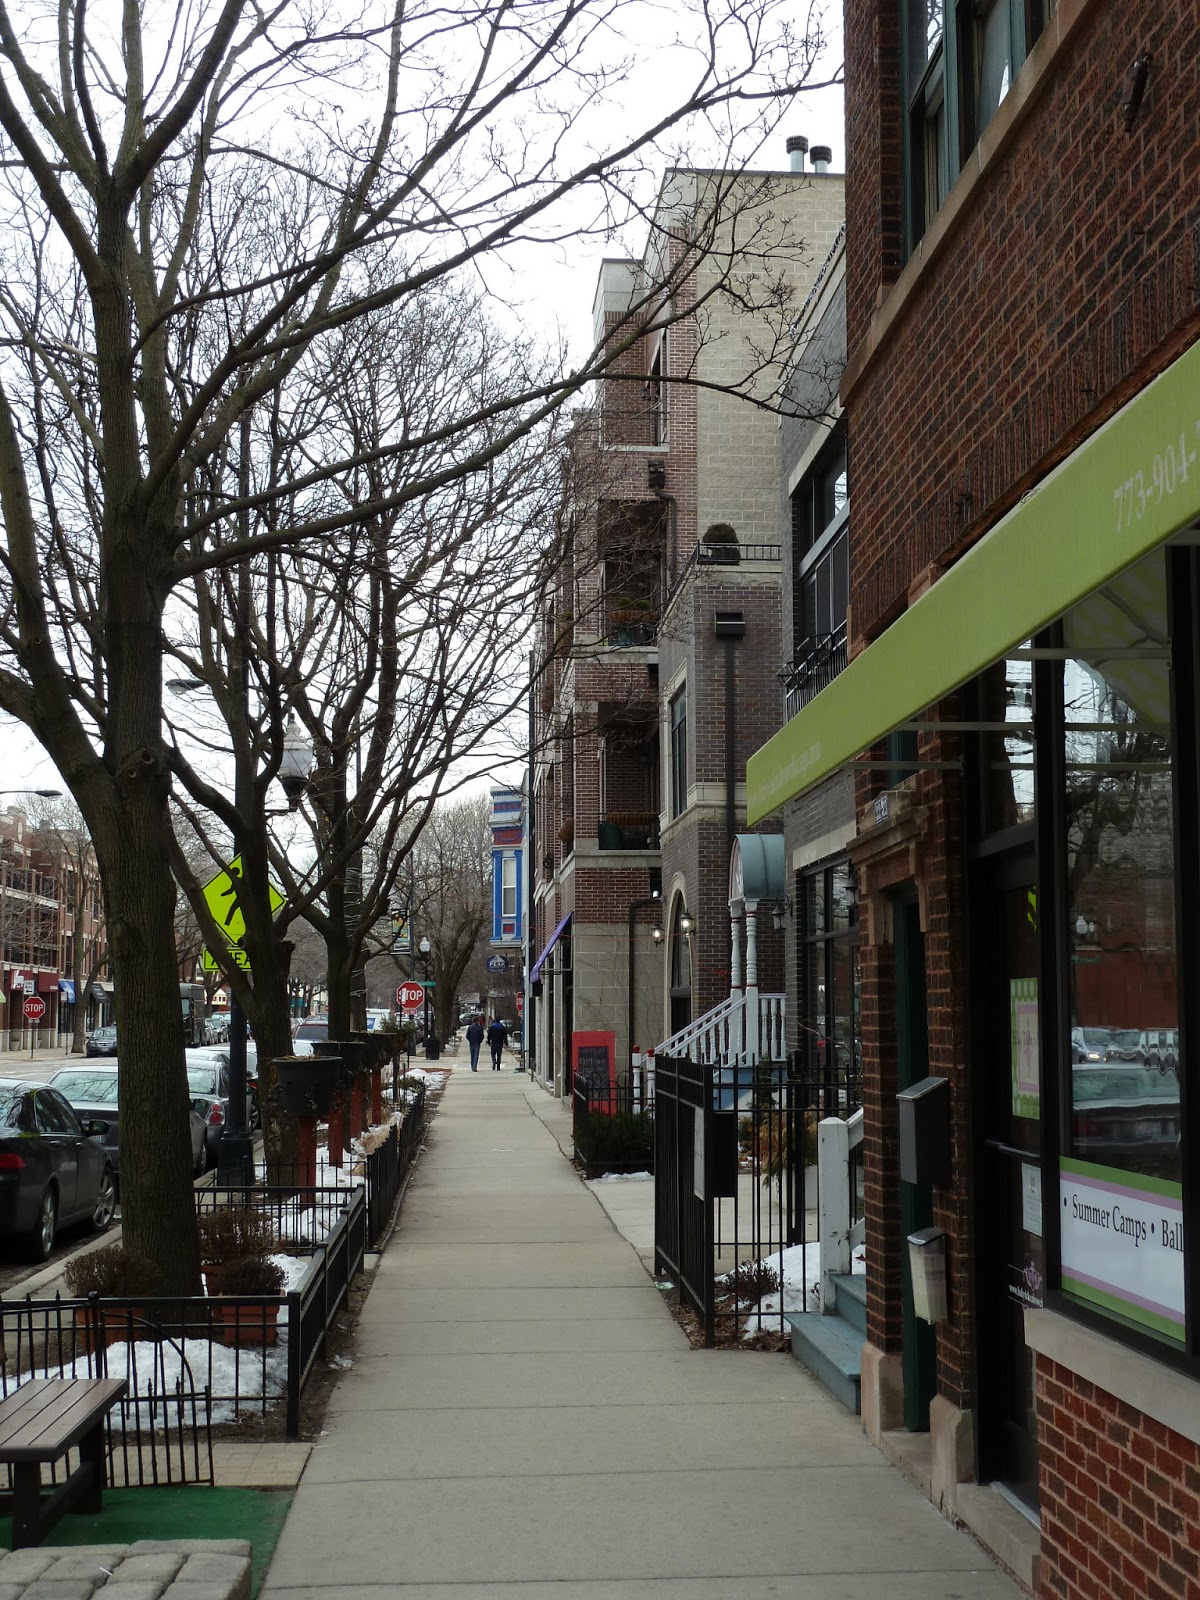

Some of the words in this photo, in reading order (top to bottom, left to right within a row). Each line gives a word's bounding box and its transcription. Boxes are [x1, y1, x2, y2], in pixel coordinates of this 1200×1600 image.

[1113, 422, 1200, 534] 773-904-
[25, 1003, 43, 1012] STOP
[1072, 1194, 1111, 1229] Summer
[1112, 1206, 1147, 1247] Camps
[1161, 1219, 1184, 1252] Ball
